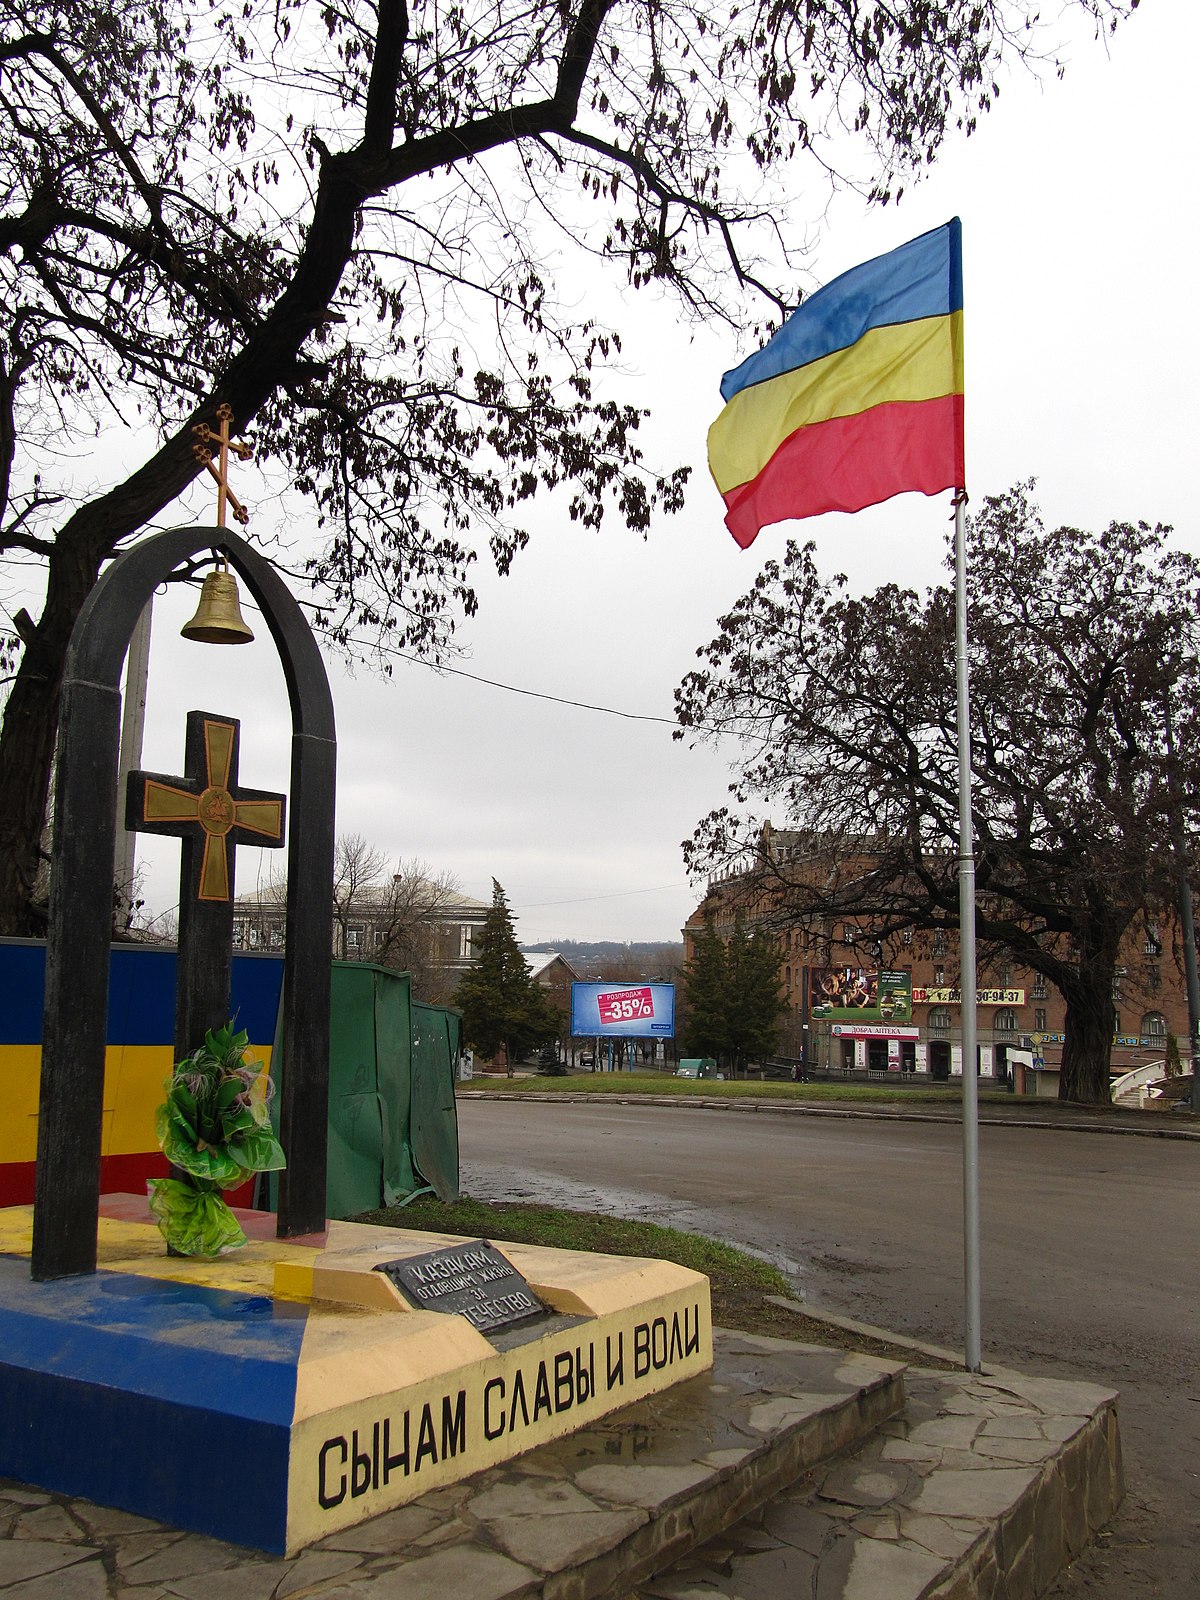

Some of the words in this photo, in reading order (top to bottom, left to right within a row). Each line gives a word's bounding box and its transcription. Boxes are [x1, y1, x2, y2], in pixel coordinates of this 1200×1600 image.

[605, 998, 651, 1019] -35%
[606, 990, 643, 1001] РОЗПРОДАЖ
[851, 1026, 873, 1034] ДОБРА
[875, 1027, 901, 1035] АПТЕКА
[411, 1250, 498, 1284] КАЗАКАМ,
[416, 1273, 478, 1300] ОТДАВШИМ
[478, 1264, 514, 1284] ЖИЗНЬ
[470, 1288, 488, 1302] ЗА
[452, 1291, 537, 1326] ТЕЧЕСТВО.
[318, 1390, 466, 1510] СЫНАМ
[484, 1342, 595, 1441] СЛАВЫ
[606, 1331, 623, 1391] И
[634, 1303, 700, 1379] ВОЛИ
